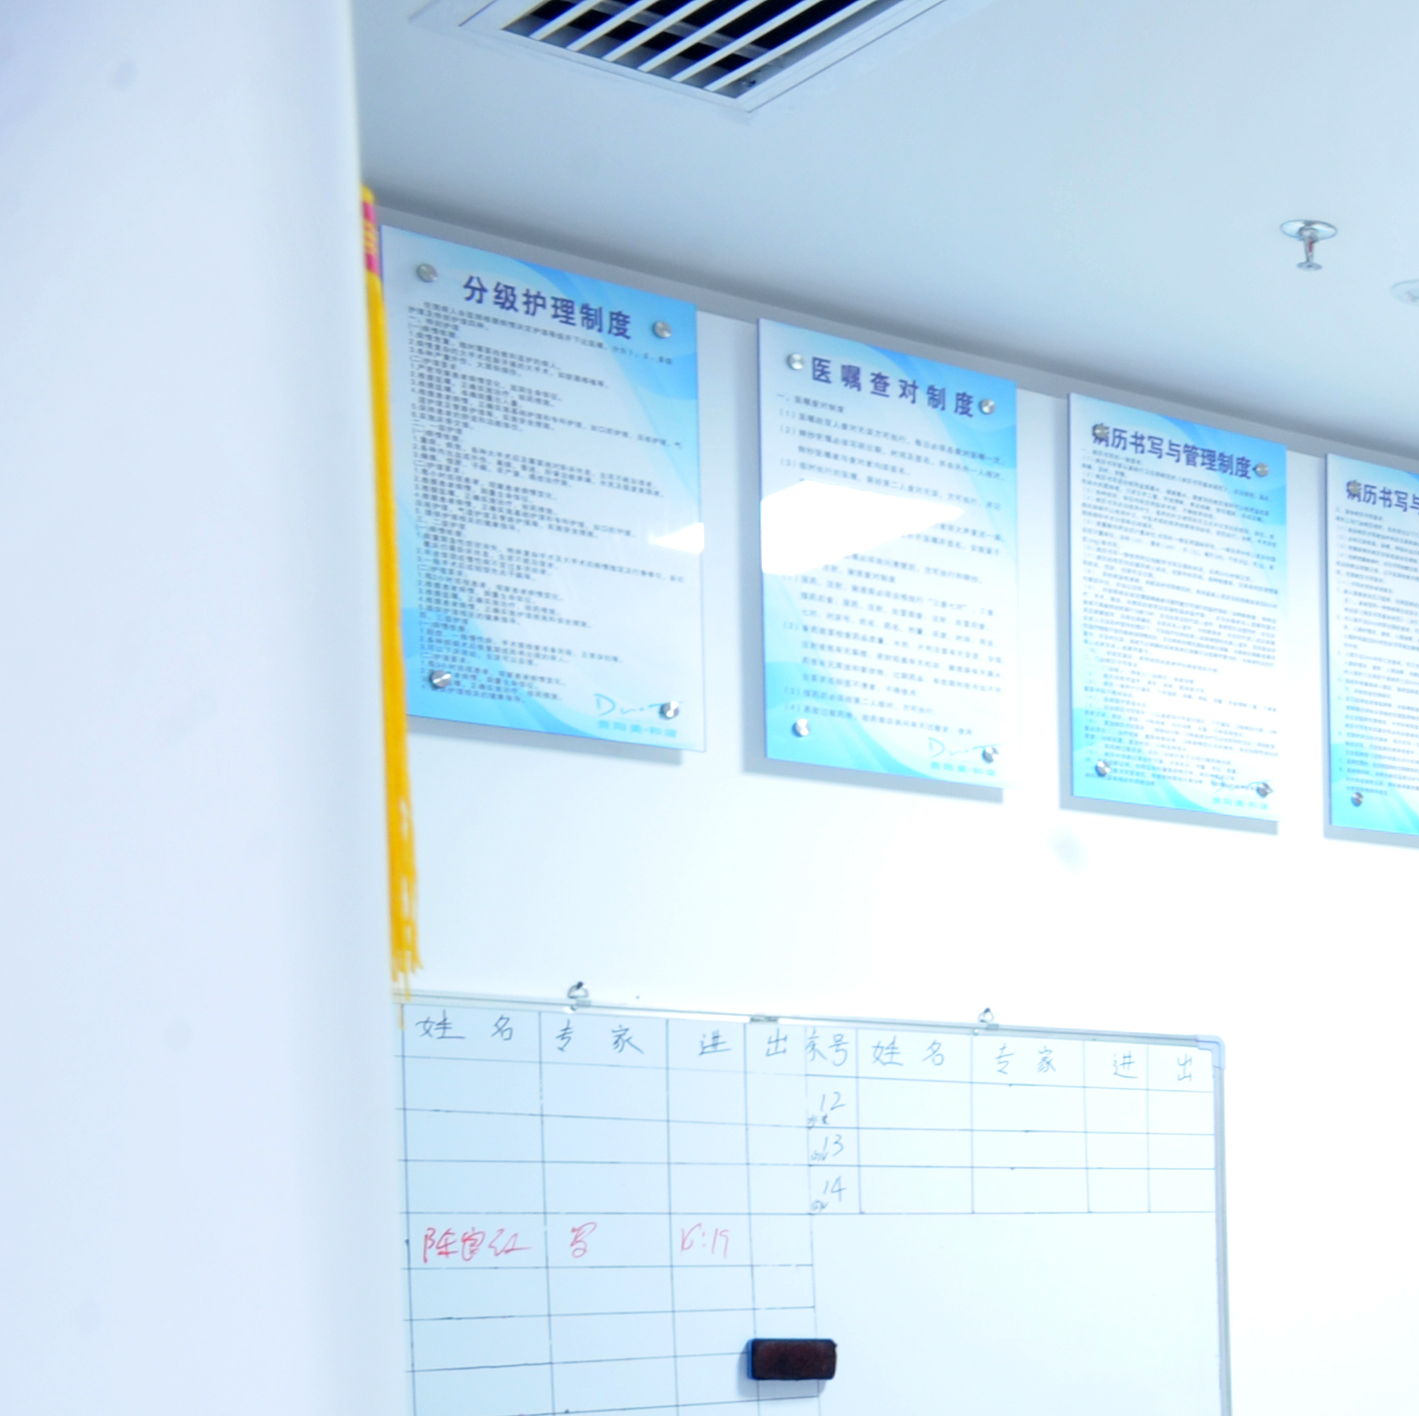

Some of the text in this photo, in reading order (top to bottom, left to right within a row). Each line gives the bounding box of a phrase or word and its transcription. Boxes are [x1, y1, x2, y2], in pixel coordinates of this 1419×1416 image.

[463, 275, 632, 340] 分级护理制度
[811, 356, 974, 418] 医嘱查对制度
